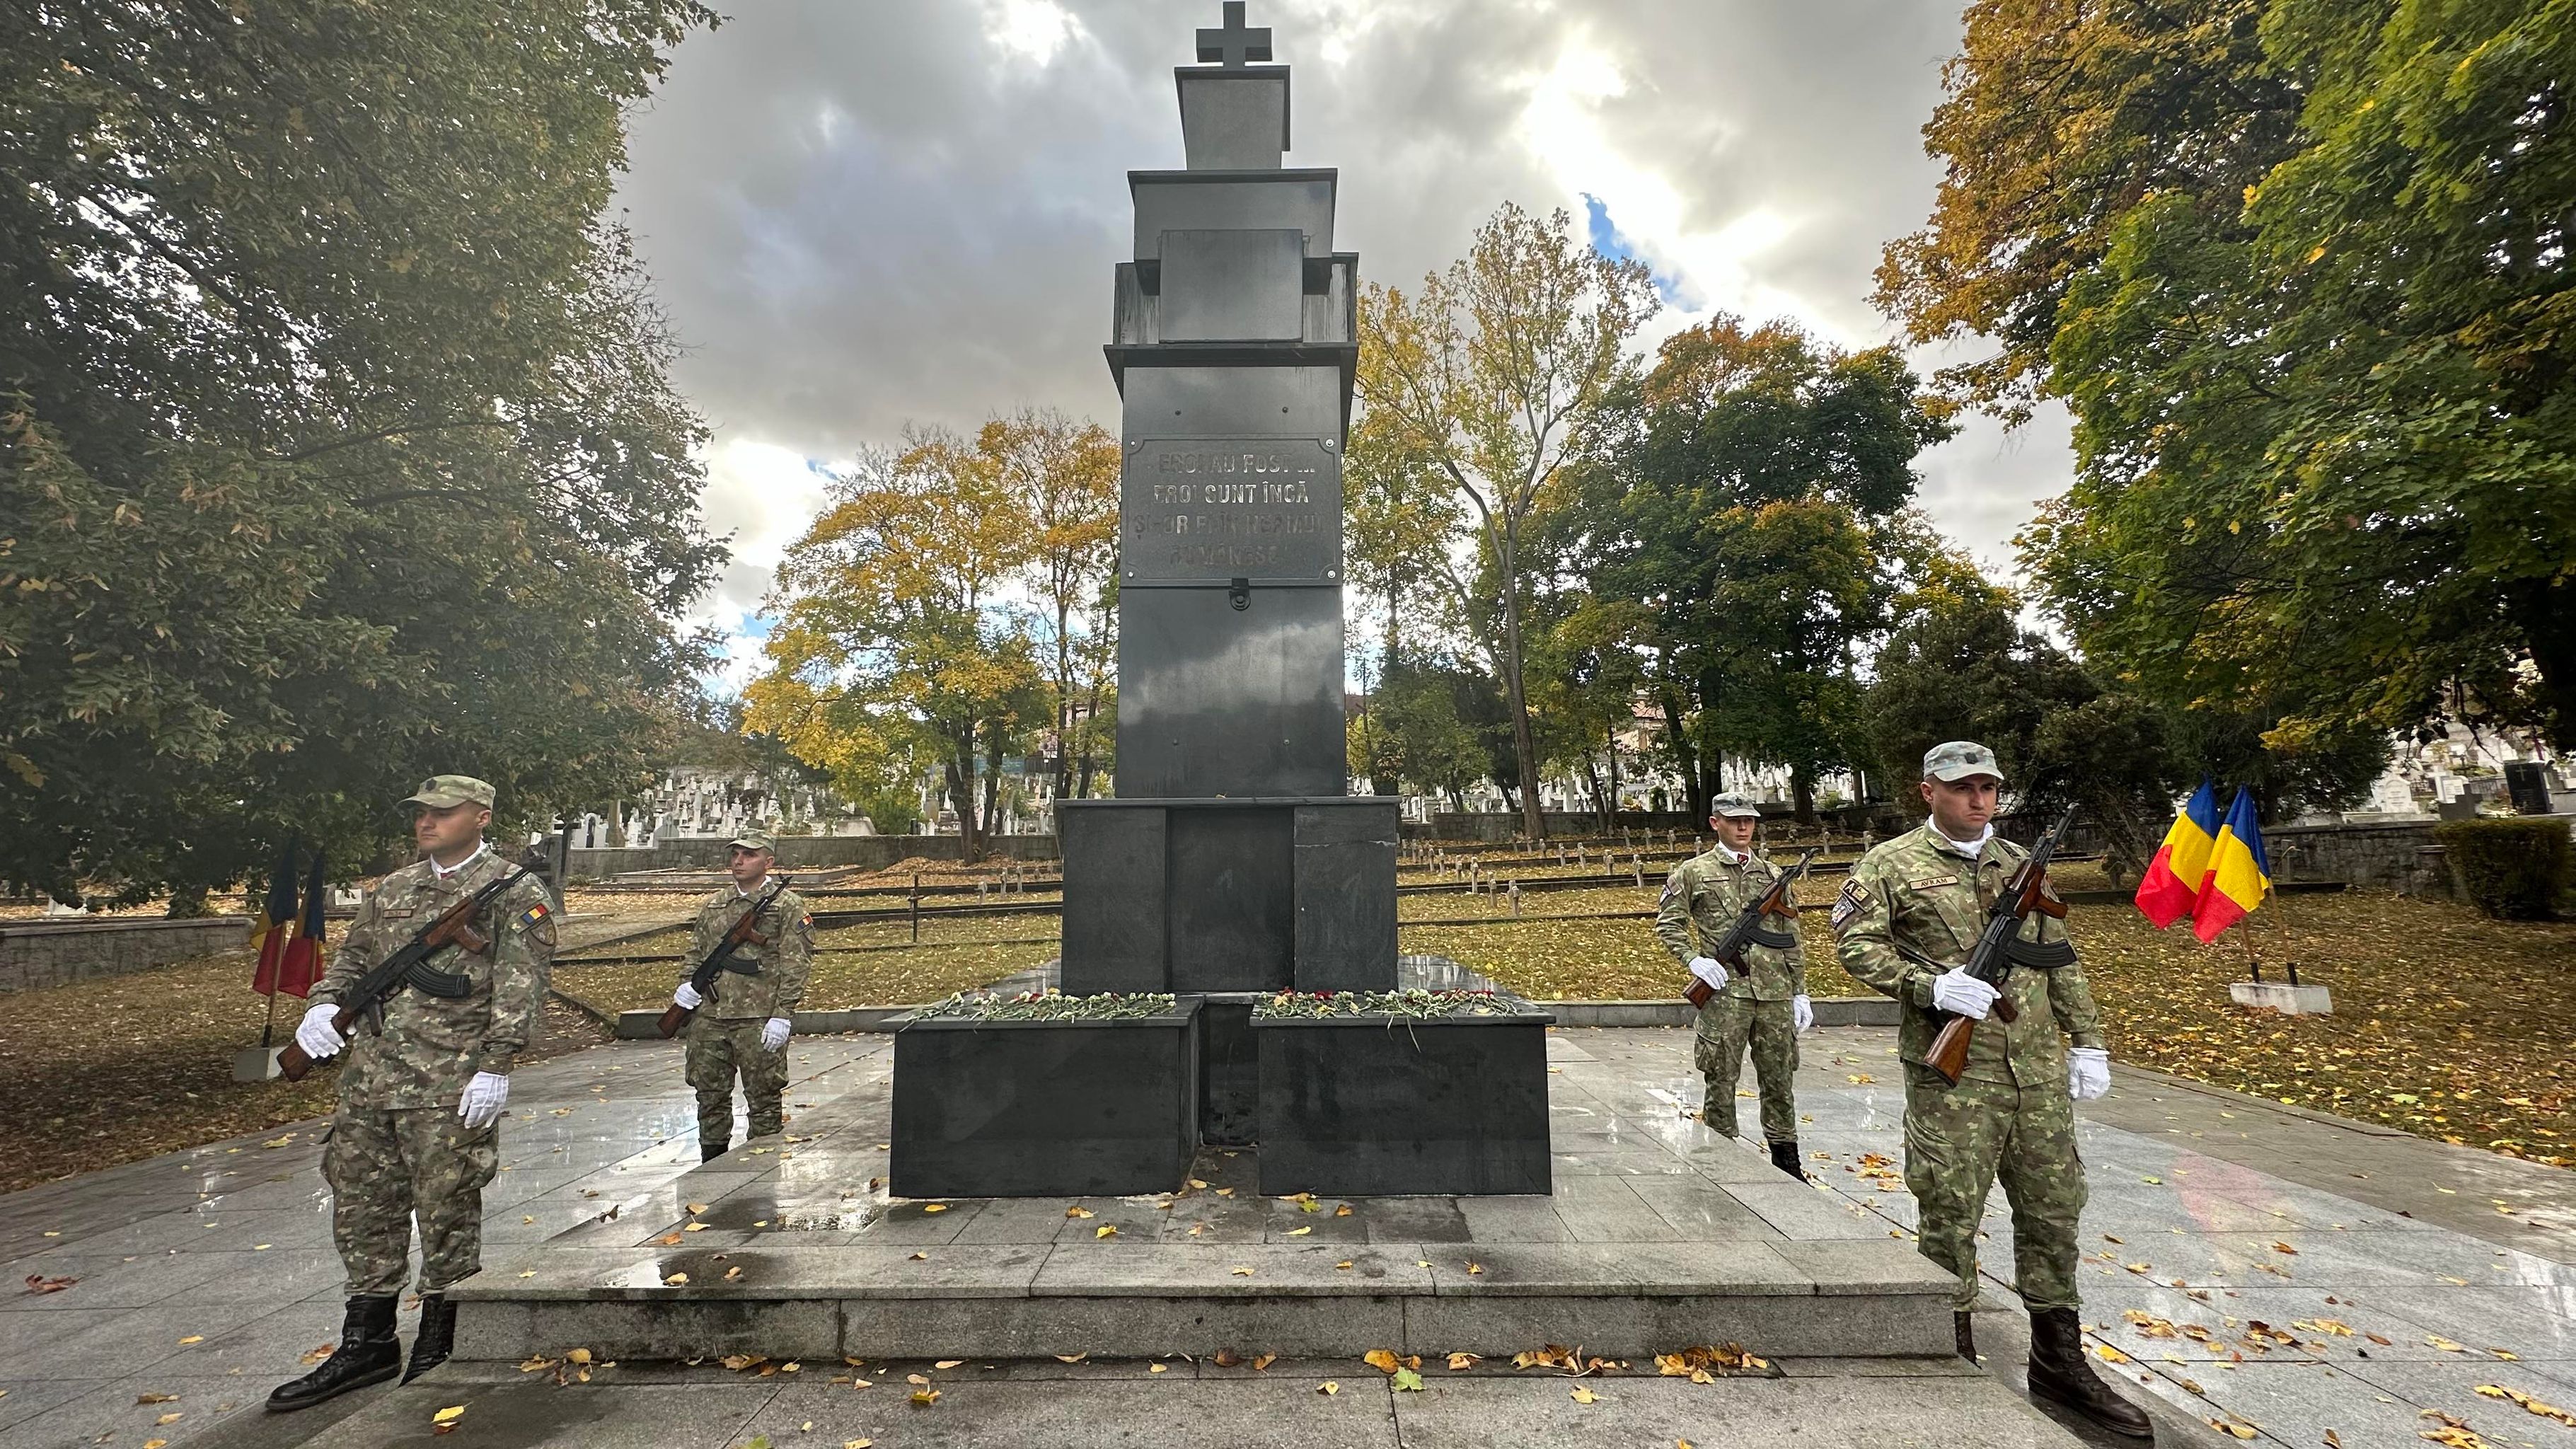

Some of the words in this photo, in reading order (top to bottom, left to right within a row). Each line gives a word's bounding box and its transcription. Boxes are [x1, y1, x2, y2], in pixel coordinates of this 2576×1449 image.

[1211, 454, 1235, 473] AU
[1243, 454, 1293, 473] FOST
[1153, 485, 1197, 503] EROI
[1205, 484, 1257, 504] SUNT
[1261, 480, 1309, 504] ÎNCĂ
[1920, 878, 1948, 887] AVRAM
